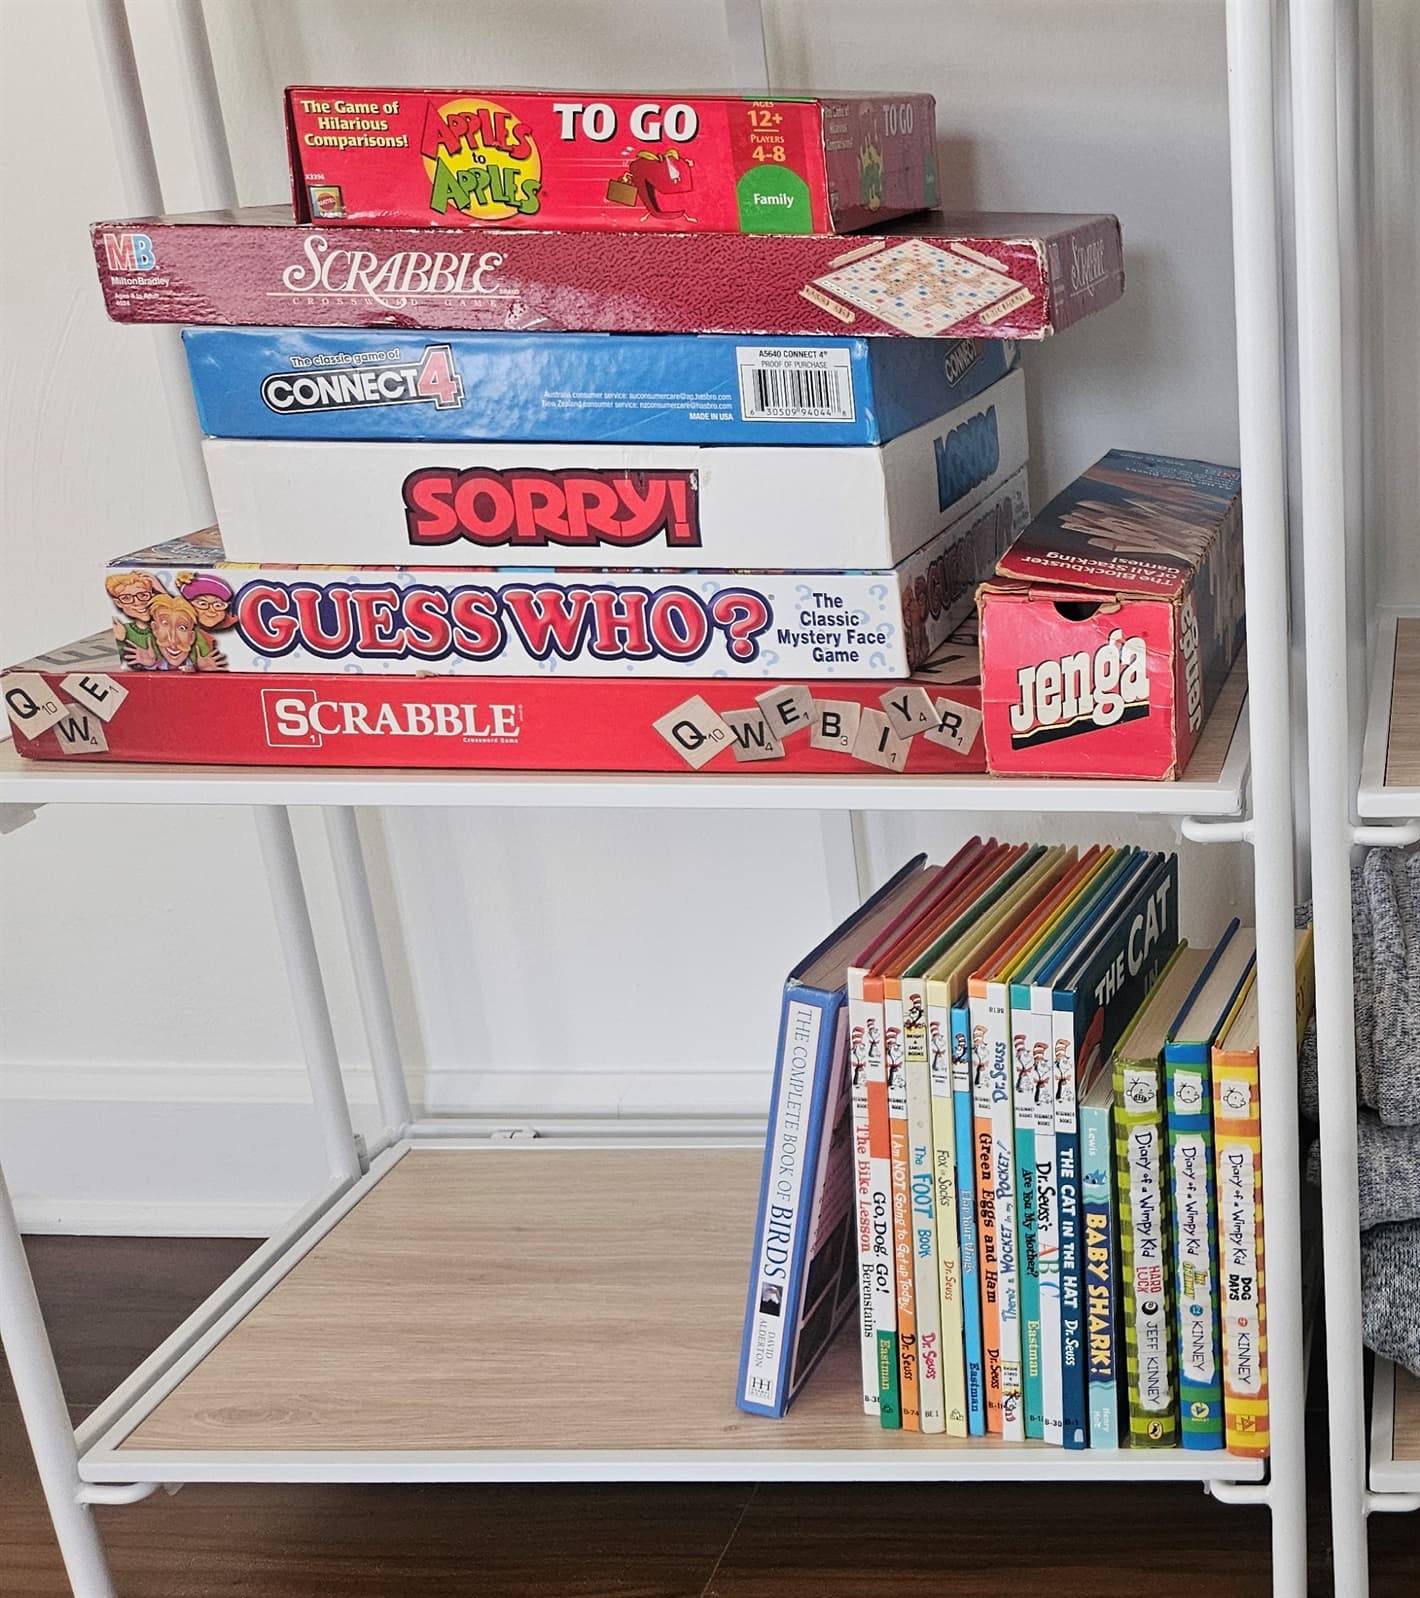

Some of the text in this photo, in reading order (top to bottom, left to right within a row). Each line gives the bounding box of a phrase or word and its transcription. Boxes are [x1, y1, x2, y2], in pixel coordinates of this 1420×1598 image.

[300, 101, 399, 114] The Game of
[320, 118, 388, 130] Hilarious
[553, 103, 699, 142] TO GO
[747, 109, 783, 128] 12+
[304, 134, 408, 149] Comparisons!
[420, 100, 533, 160] APPLES
[750, 134, 785, 144] PLAYERS
[472, 153, 486, 164] to
[752, 145, 786, 163] 4-8
[430, 157, 541, 214] APPLES
[753, 193, 794, 208] Family
[104, 233, 156, 271] MB
[291, 348, 400, 367] The classic game of
[760, 350, 782, 358] A5640
[267, 350, 459, 408] CONNECT 4
[767, 408, 797, 416] 30509
[404, 471, 697, 544] SORRY!
[1020, 556, 1136, 580] Blockbuster
[1046, 552, 1128, 572] Stacking
[1112, 557, 1180, 574] Games!
[800, 610, 860, 627] Classic
[813, 592, 843, 609] The
[237, 584, 771, 661] GUESS WHO?
[778, 628, 886, 648] Mystery Face
[812, 648, 859, 663] Game
[1010, 629, 1149, 732] Jenga
[1095, 875, 1171, 1006] THE CAT
[990, 1042, 1008, 1103] Dr. Seuss
[764, 1010, 812, 1278] THE COMPLETE BOOK OF BIRDS
[1135, 1132, 1152, 1169] Diary
[856, 1125, 872, 1252] The Bike Lesson
[1036, 1161, 1054, 1232] Dr. Seuss's
[1144, 1174, 1152, 1184] of
[913, 1146, 933, 1258] The FOOT BOOK
[979, 1133, 998, 1303] Green Eggs and Ham
[1136, 1195, 1153, 1236] Wimpy
[873, 1192, 890, 1294] Go, Dog. Go!
[1060, 1148, 1077, 1309] THE CAT IN THE HAT
[1142, 1238, 1157, 1259] Kid
[1086, 1214, 1111, 1376] BABY SHARK!
[1136, 1266, 1148, 1294] LUCK
[1149, 1266, 1162, 1293] HARD
[1229, 1274, 1240, 1301] DAYS
[1241, 1278, 1252, 1301] DOG
[863, 1264, 876, 1337] Berenstains
[1065, 1320, 1079, 1366] Dr. Seuss
[1192, 1321, 1205, 1372] KINNEY
[1238, 1332, 1251, 1385] KINNEY
[1146, 1321, 1160, 1406] JEFF KINNEY
